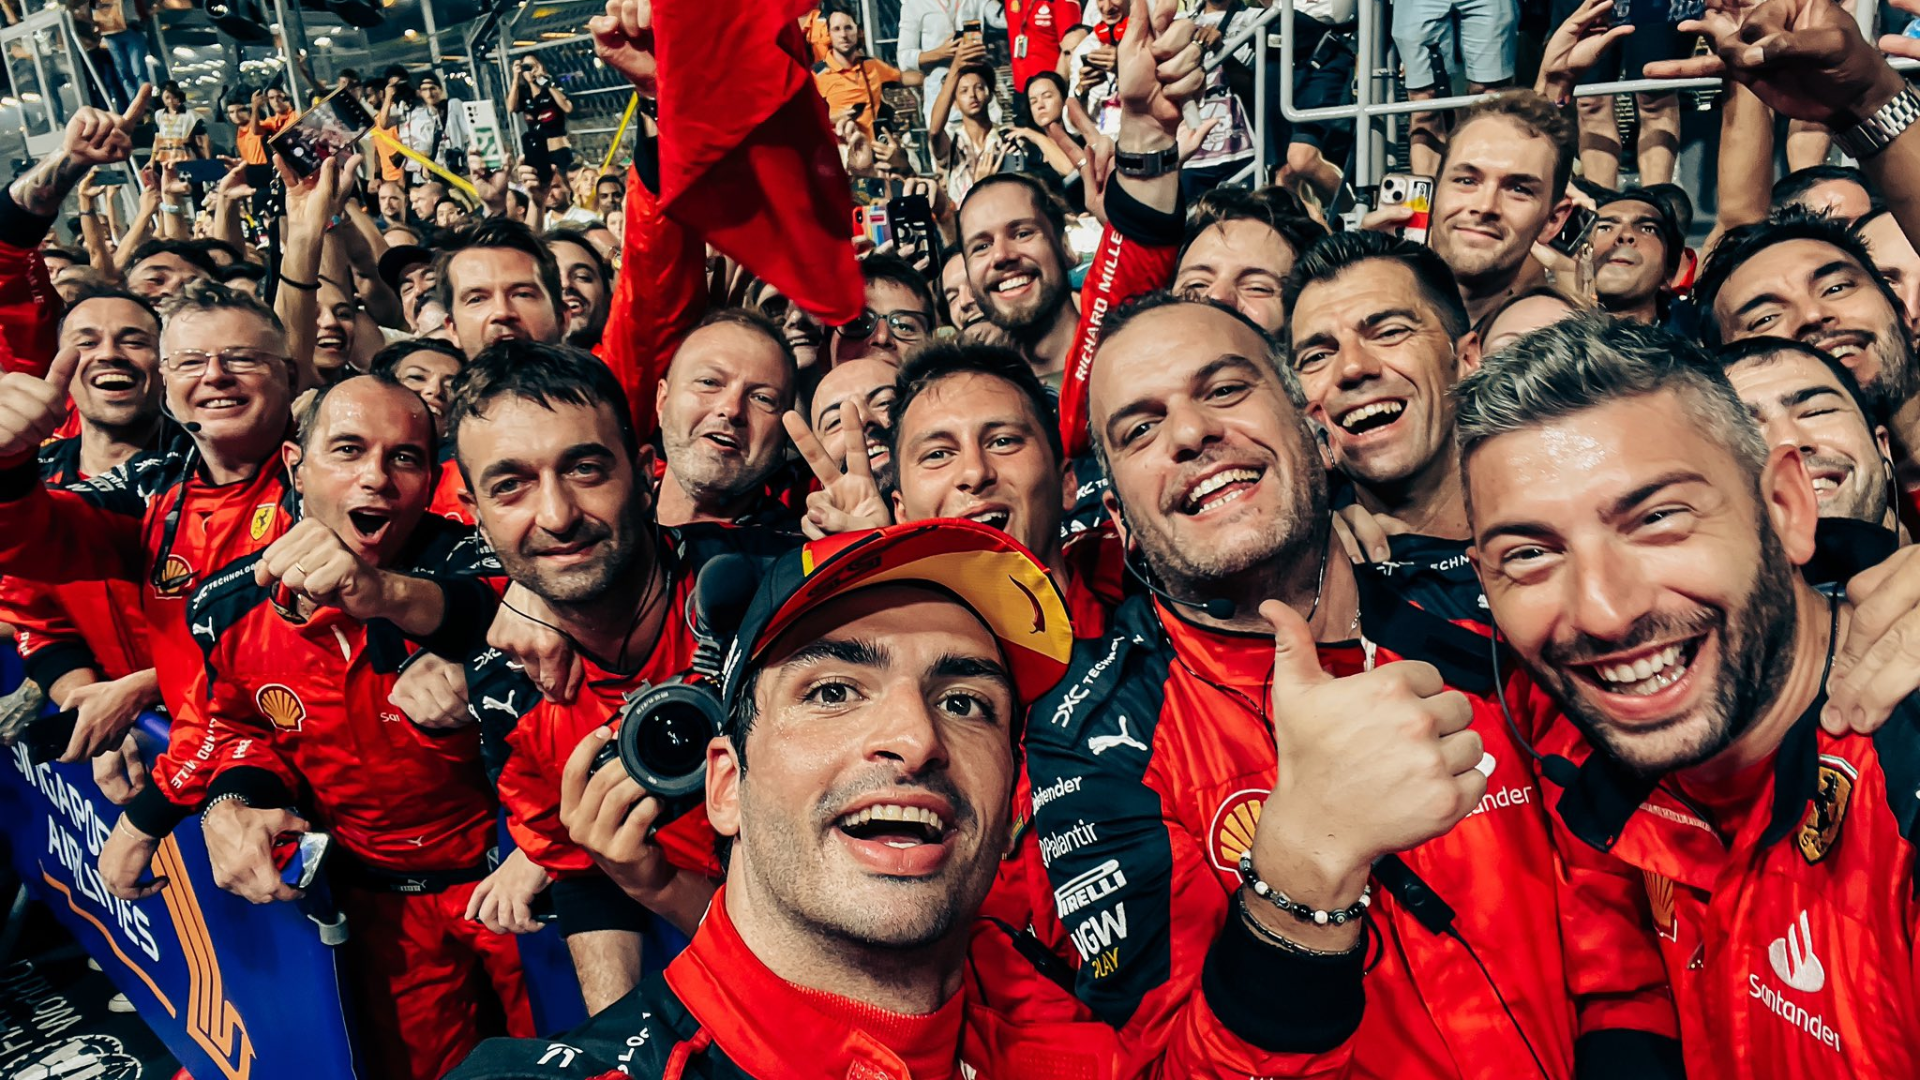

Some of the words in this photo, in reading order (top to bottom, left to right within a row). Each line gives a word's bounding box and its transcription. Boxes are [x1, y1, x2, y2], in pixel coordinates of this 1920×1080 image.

[1075, 297, 1108, 382] RICHARD
[1098, 229, 1123, 293] MILLE
[208, 563, 256, 591] TECHNOLOG
[1051, 684, 1091, 728] DXC
[1082, 633, 1145, 684] TECHNOLY
[11, 741, 112, 856] SINGAPOR
[1042, 818, 1098, 864] Palantir
[1054, 859, 1127, 919] PIRELLI
[1070, 901, 1127, 962] VGW
[1091, 946, 1119, 979] PLAY
[1749, 973, 1840, 1052] Santander
